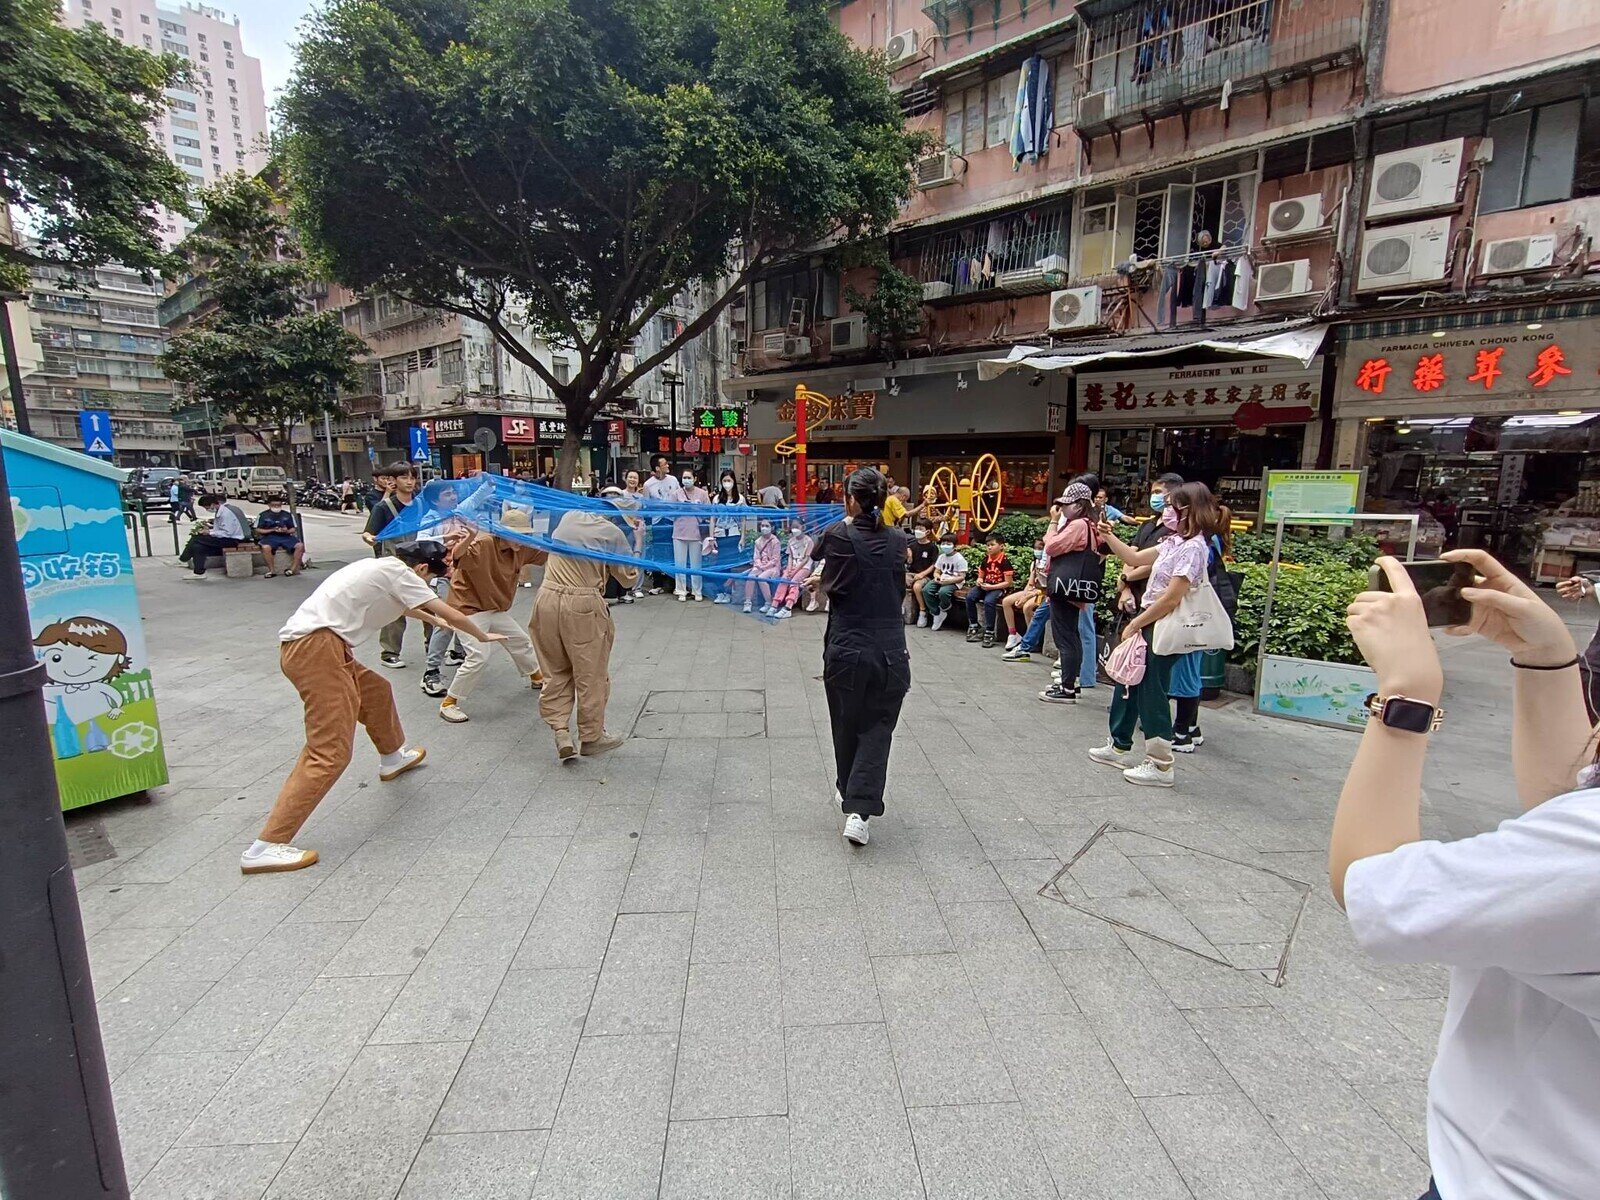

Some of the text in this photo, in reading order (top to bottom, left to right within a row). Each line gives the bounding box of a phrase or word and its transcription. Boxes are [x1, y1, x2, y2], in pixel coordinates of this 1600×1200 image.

[1381, 342, 1428, 352] FARMACIA
[1480, 335, 1518, 345] CHONG
[1522, 333, 1555, 341] KONG
[1169, 364, 1268, 380] FERRAGENS VAI KEI
[1055, 577, 1099, 600] NARS
